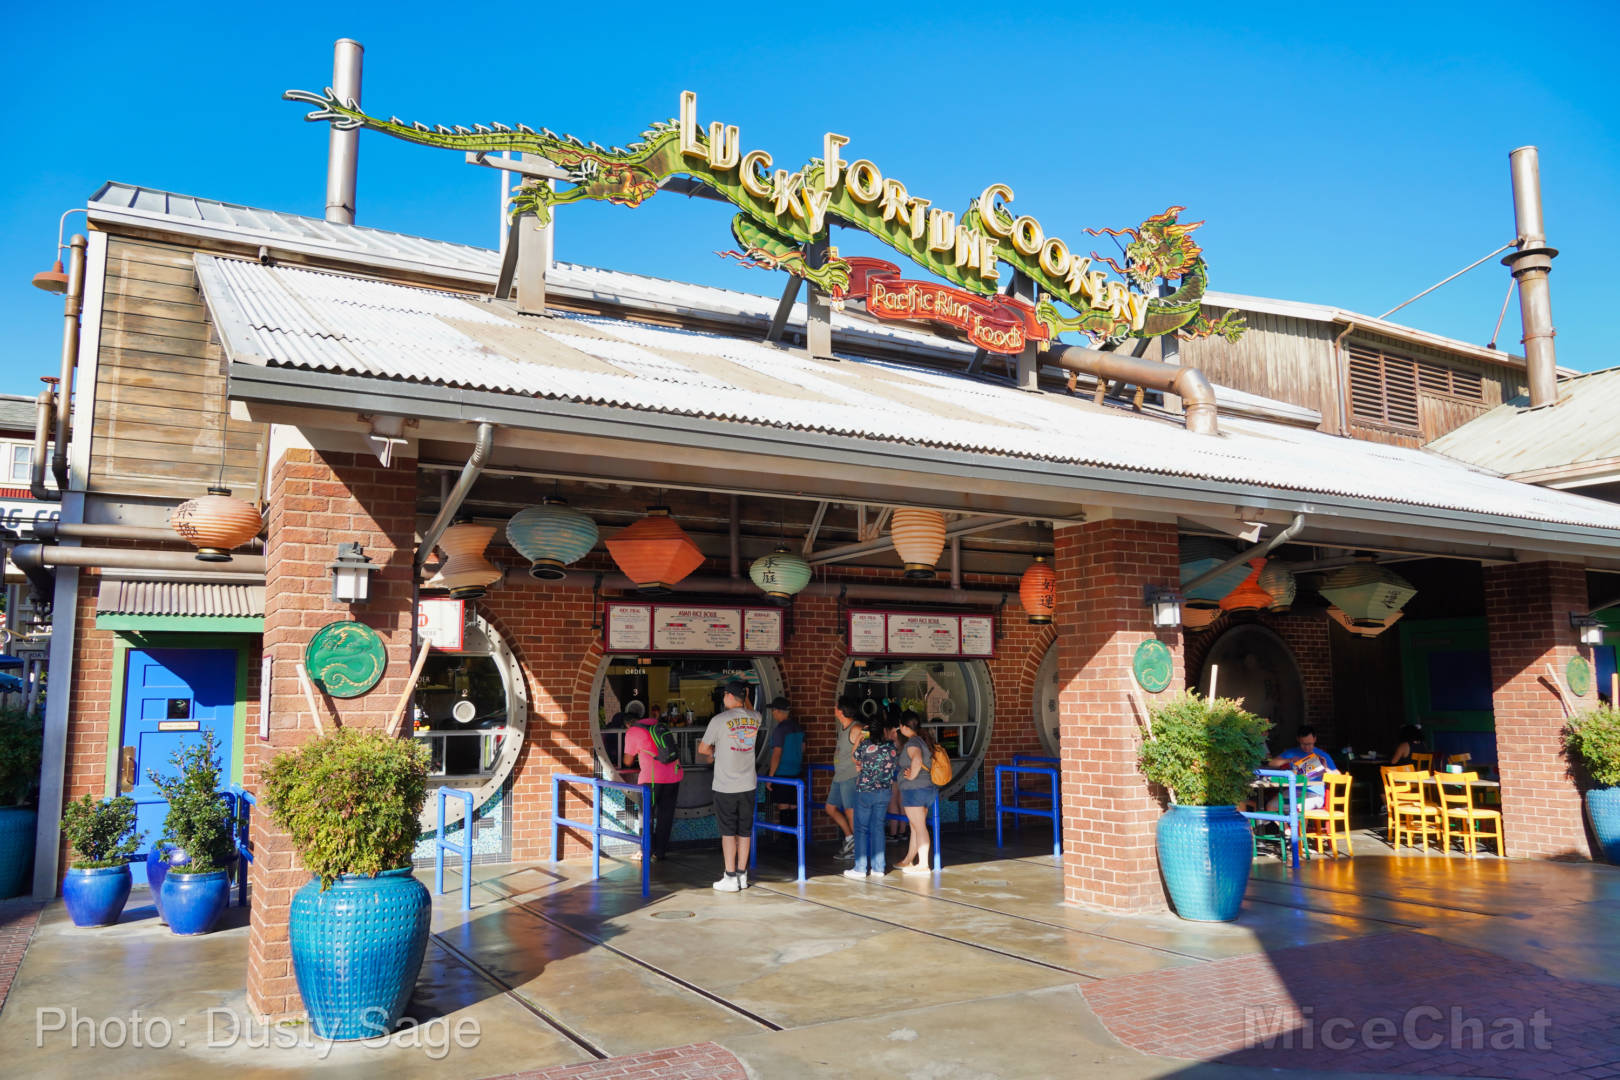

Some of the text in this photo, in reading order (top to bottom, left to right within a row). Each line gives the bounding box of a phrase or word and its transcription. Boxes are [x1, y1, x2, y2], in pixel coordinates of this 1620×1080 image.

[680, 90, 1149, 331] LUCKY FORTUNE COOKERY
[872, 283, 932, 310] Pacific
[974, 316, 1021, 347] Foods
